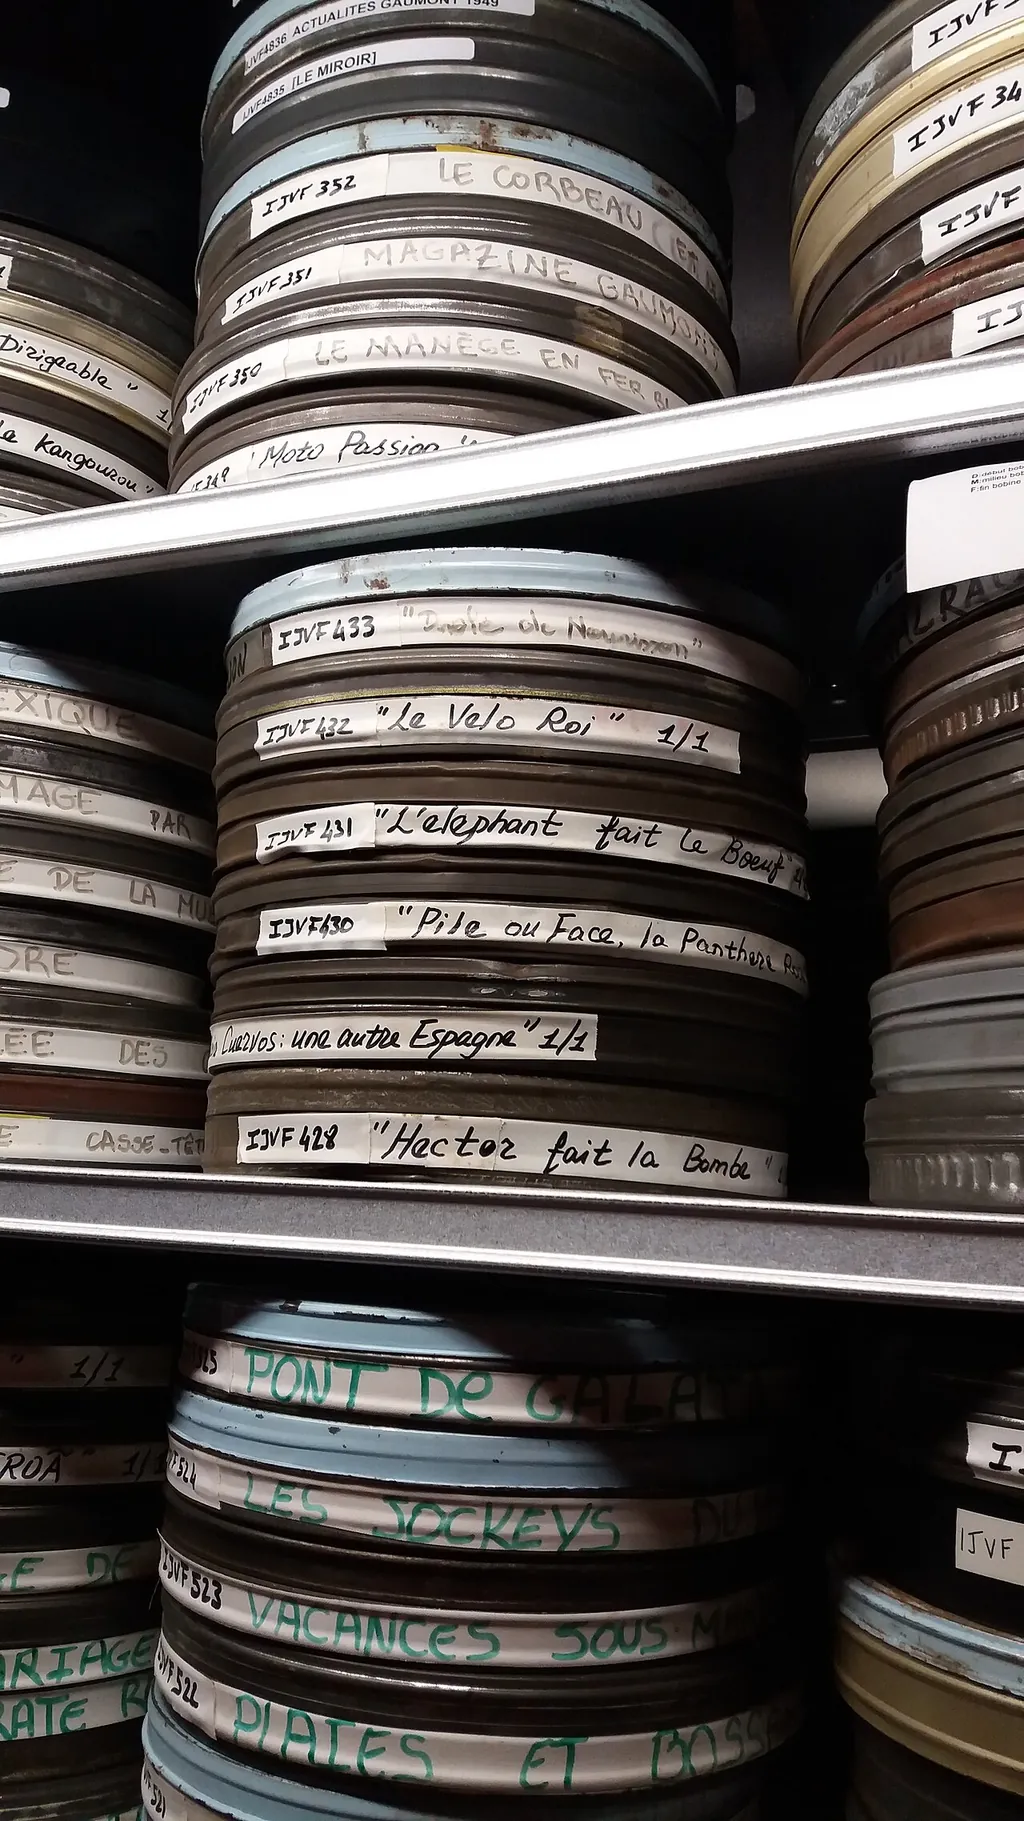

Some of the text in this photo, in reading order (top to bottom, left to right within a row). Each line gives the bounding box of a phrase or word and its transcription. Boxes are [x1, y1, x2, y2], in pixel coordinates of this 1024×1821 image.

[292, 2, 376, 37] ACTUALITES
[291, 71, 313, 90] [LE
[317, 51, 377, 78] MIROIR]
[438, 157, 475, 186] LE
[492, 164, 643, 232] CORBEAU
[362, 240, 578, 286] MAGAZINE
[314, 339, 349, 366] LE
[539, 348, 580, 370] EN
[597, 366, 646, 400] FER
[992, 479, 1021, 489] bobine
[449, 702, 516, 732] Velo
[657, 723, 709, 753] 1/1
[149, 808, 193, 841] PAR
[594, 815, 662, 851] fait
[47, 865, 96, 893] DE
[129, 878, 157, 908] LA
[504, 920, 542, 939] ou
[640, 921, 669, 950] la
[118, 1038, 169, 1069] DES
[291, 1028, 333, 1050] une
[337, 1023, 400, 1050] autre
[538, 1018, 589, 1057] 1/1
[542, 1130, 613, 1176] fait
[627, 1140, 660, 1169] la
[243, 1347, 390, 1411] PONT
[243, 1471, 329, 1524] LES
[371, 1493, 621, 1553] JOCKEYS
[246, 1589, 501, 1661] VACANCES
[551, 1619, 669, 1662] SOUS
[519, 1735, 589, 1790] ET
